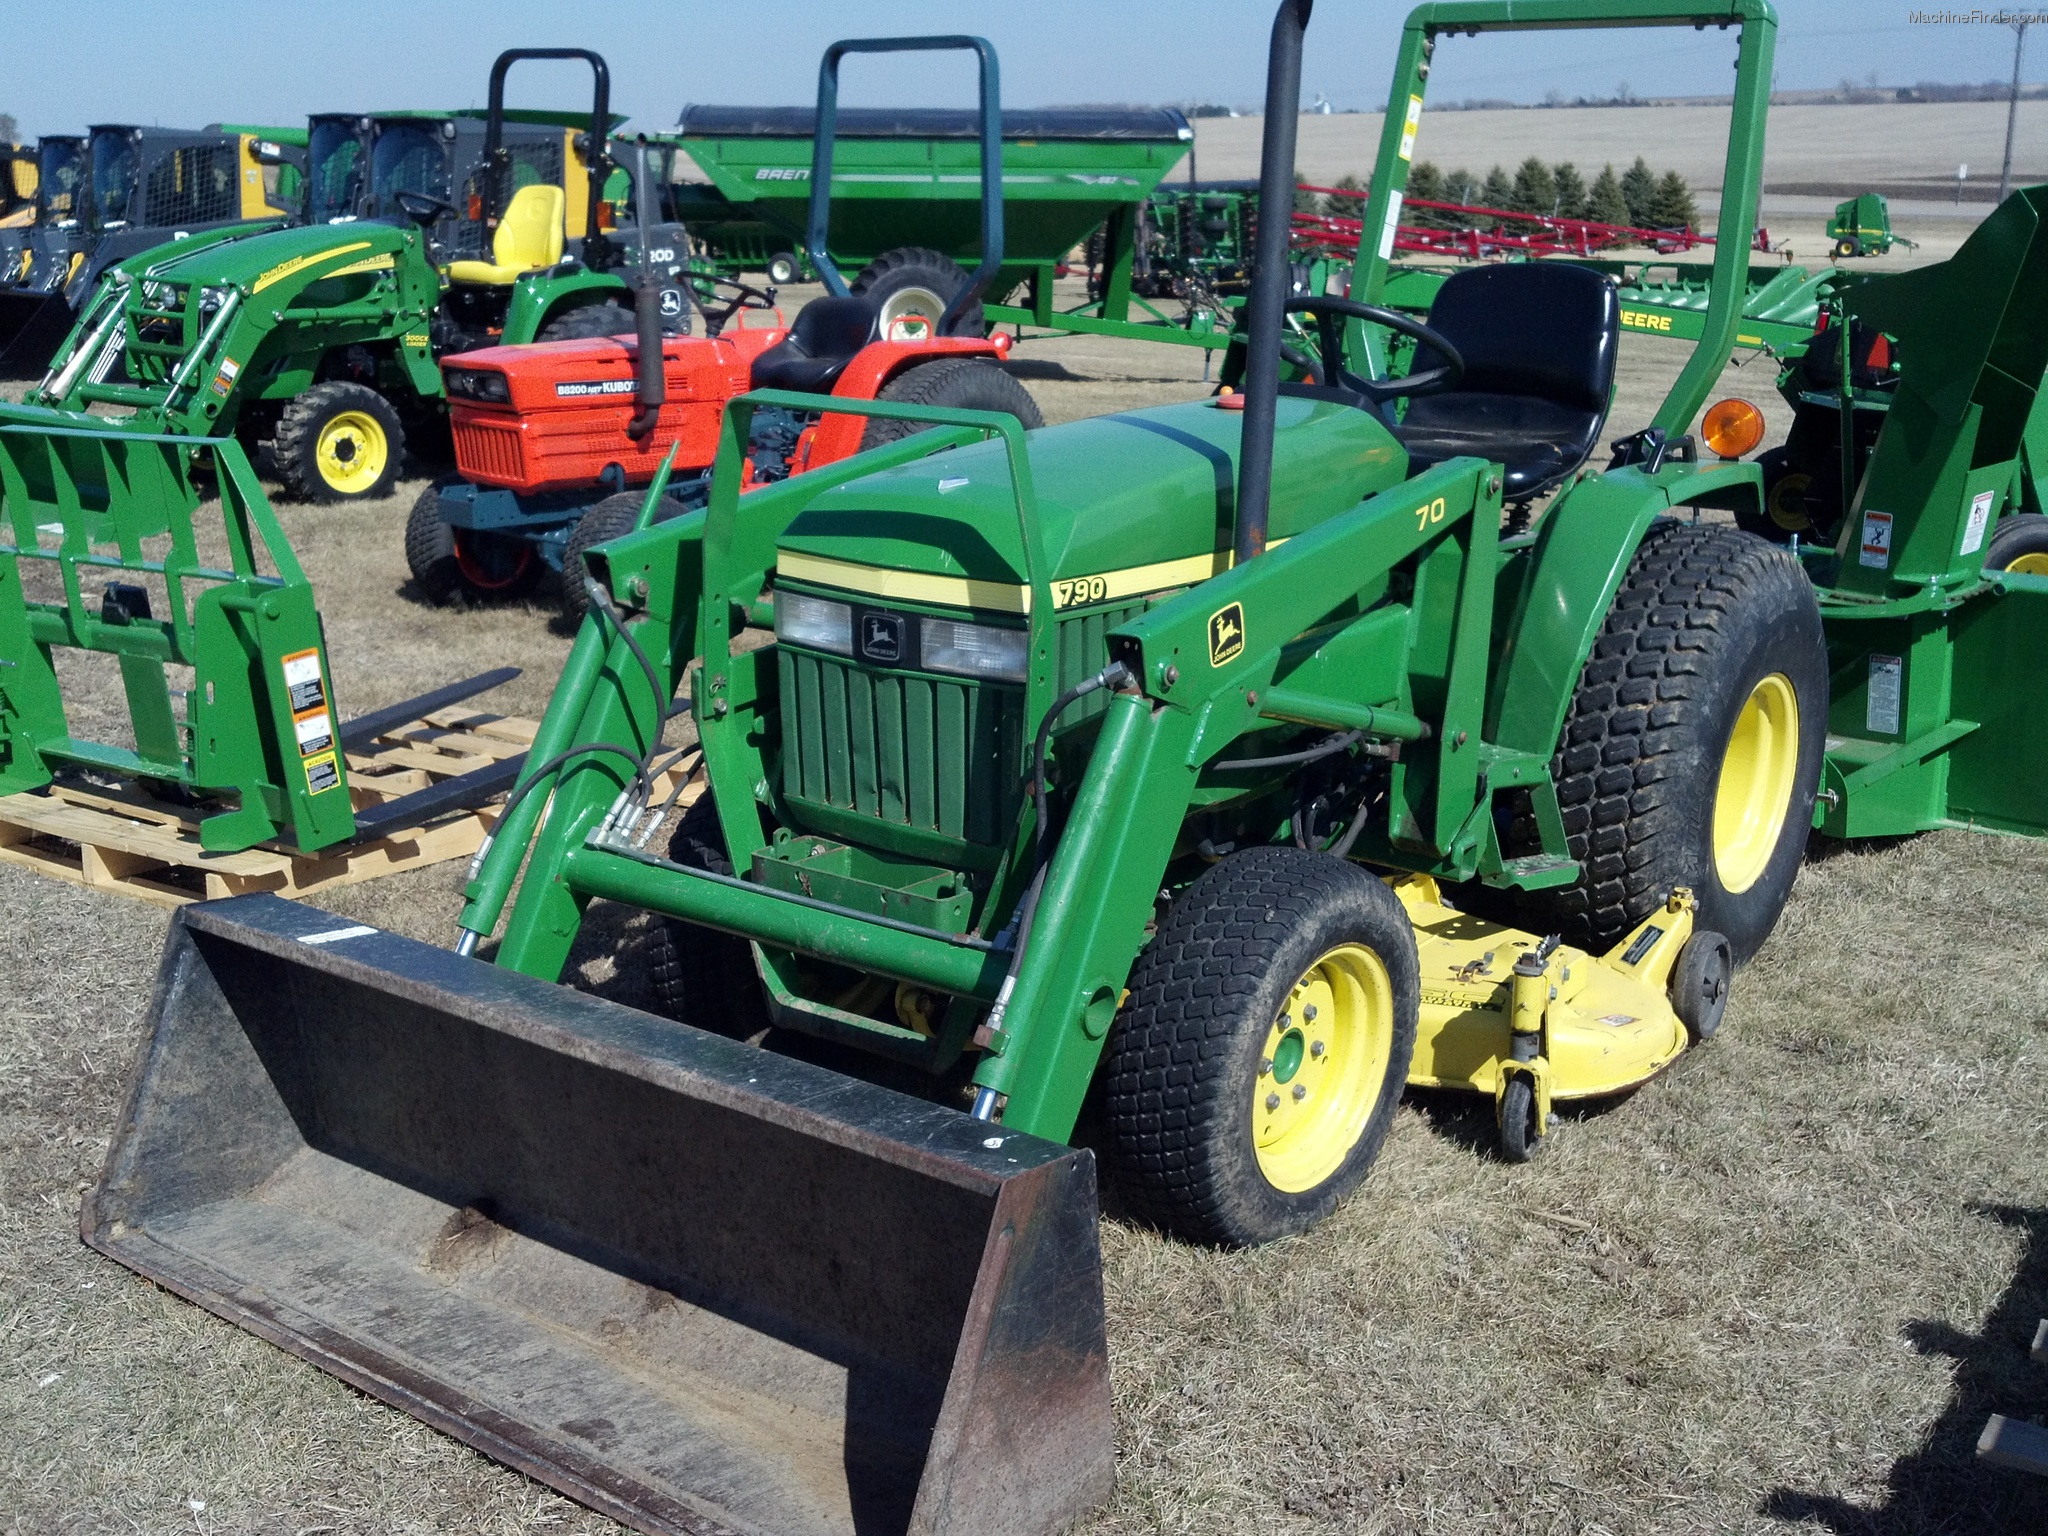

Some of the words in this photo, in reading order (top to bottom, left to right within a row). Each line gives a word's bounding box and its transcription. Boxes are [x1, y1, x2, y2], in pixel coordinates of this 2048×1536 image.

[755, 169, 811, 180] BREN
[258, 268, 278, 282] JOHN
[278, 255, 303, 274] DEERE
[1620, 309, 1673, 331] EERE
[557, 385, 587, 395] B8200
[1415, 497, 1445, 532] 70
[1060, 577, 1107, 607] 790
[1213, 650, 1226, 663] JOHN
[1225, 641, 1242, 656] DEERE
